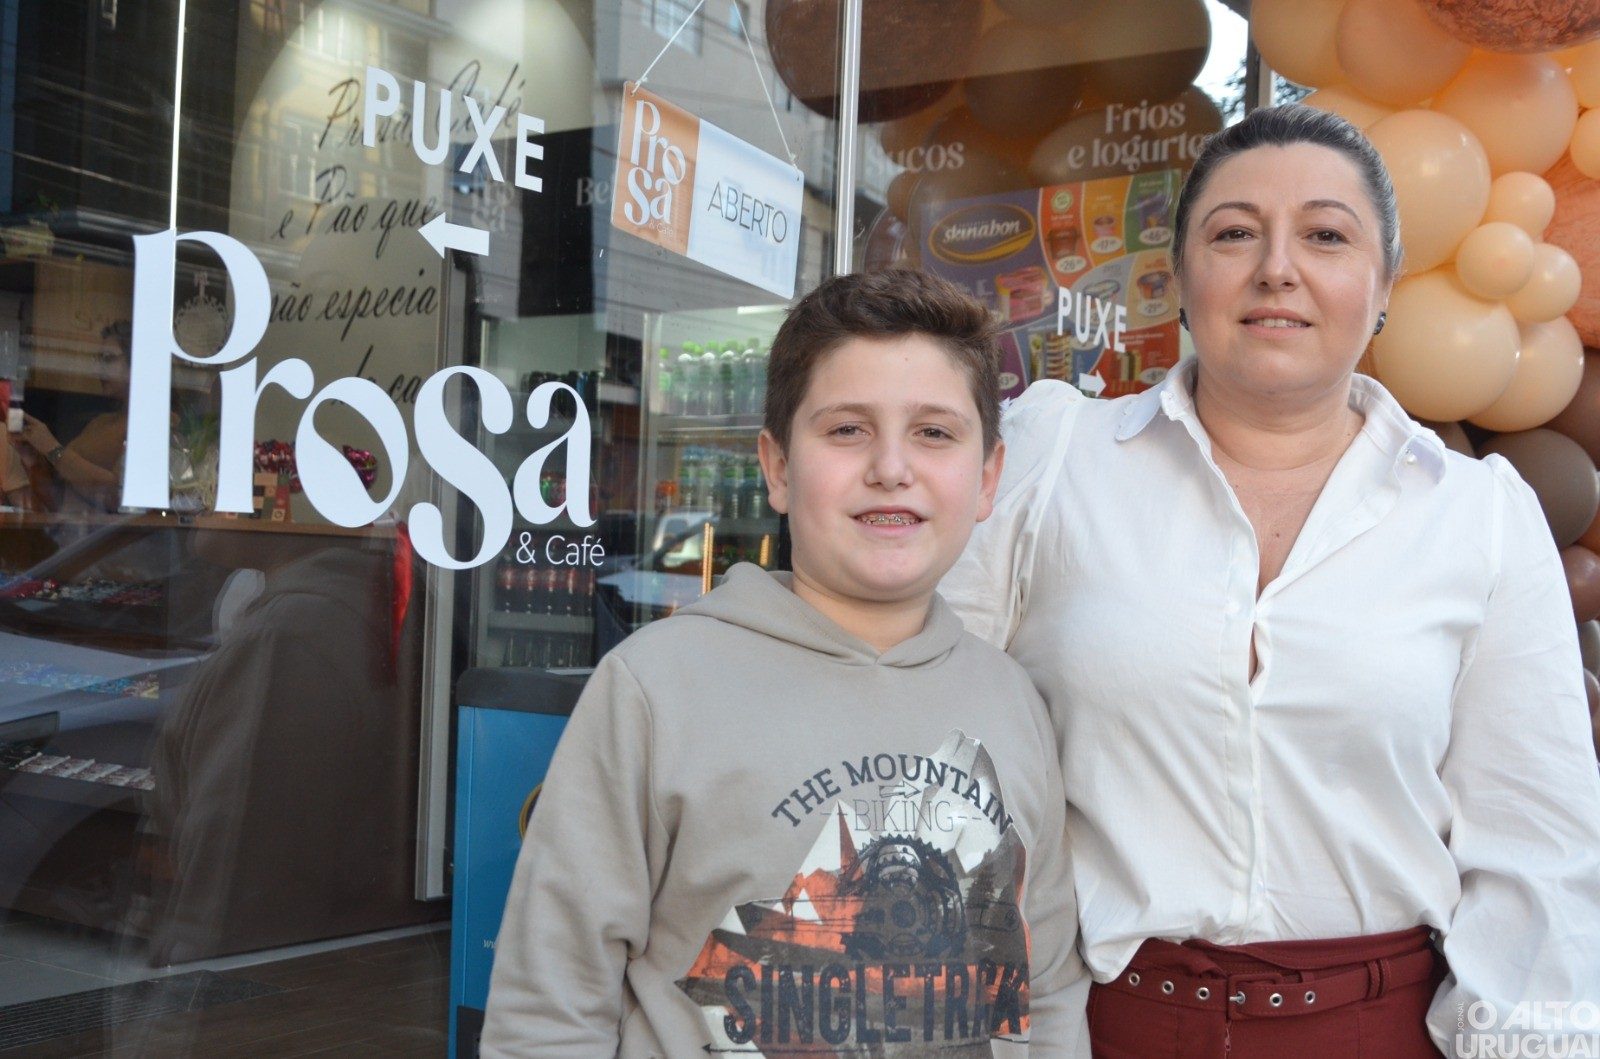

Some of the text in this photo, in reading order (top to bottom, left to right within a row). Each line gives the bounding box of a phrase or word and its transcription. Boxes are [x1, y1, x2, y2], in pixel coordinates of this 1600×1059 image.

[362, 65, 545, 193] PUXE
[1105, 99, 1186, 134] Frios
[1067, 144, 1086, 170] e
[707, 181, 788, 243] ABERTO
[1057, 286, 1127, 353] PUXE
[121, 229, 597, 570] Prosa
[516, 531, 606, 567] & Café
[771, 753, 1014, 836] THE MOUNTAIN
[853, 799, 954, 833] BIKING
